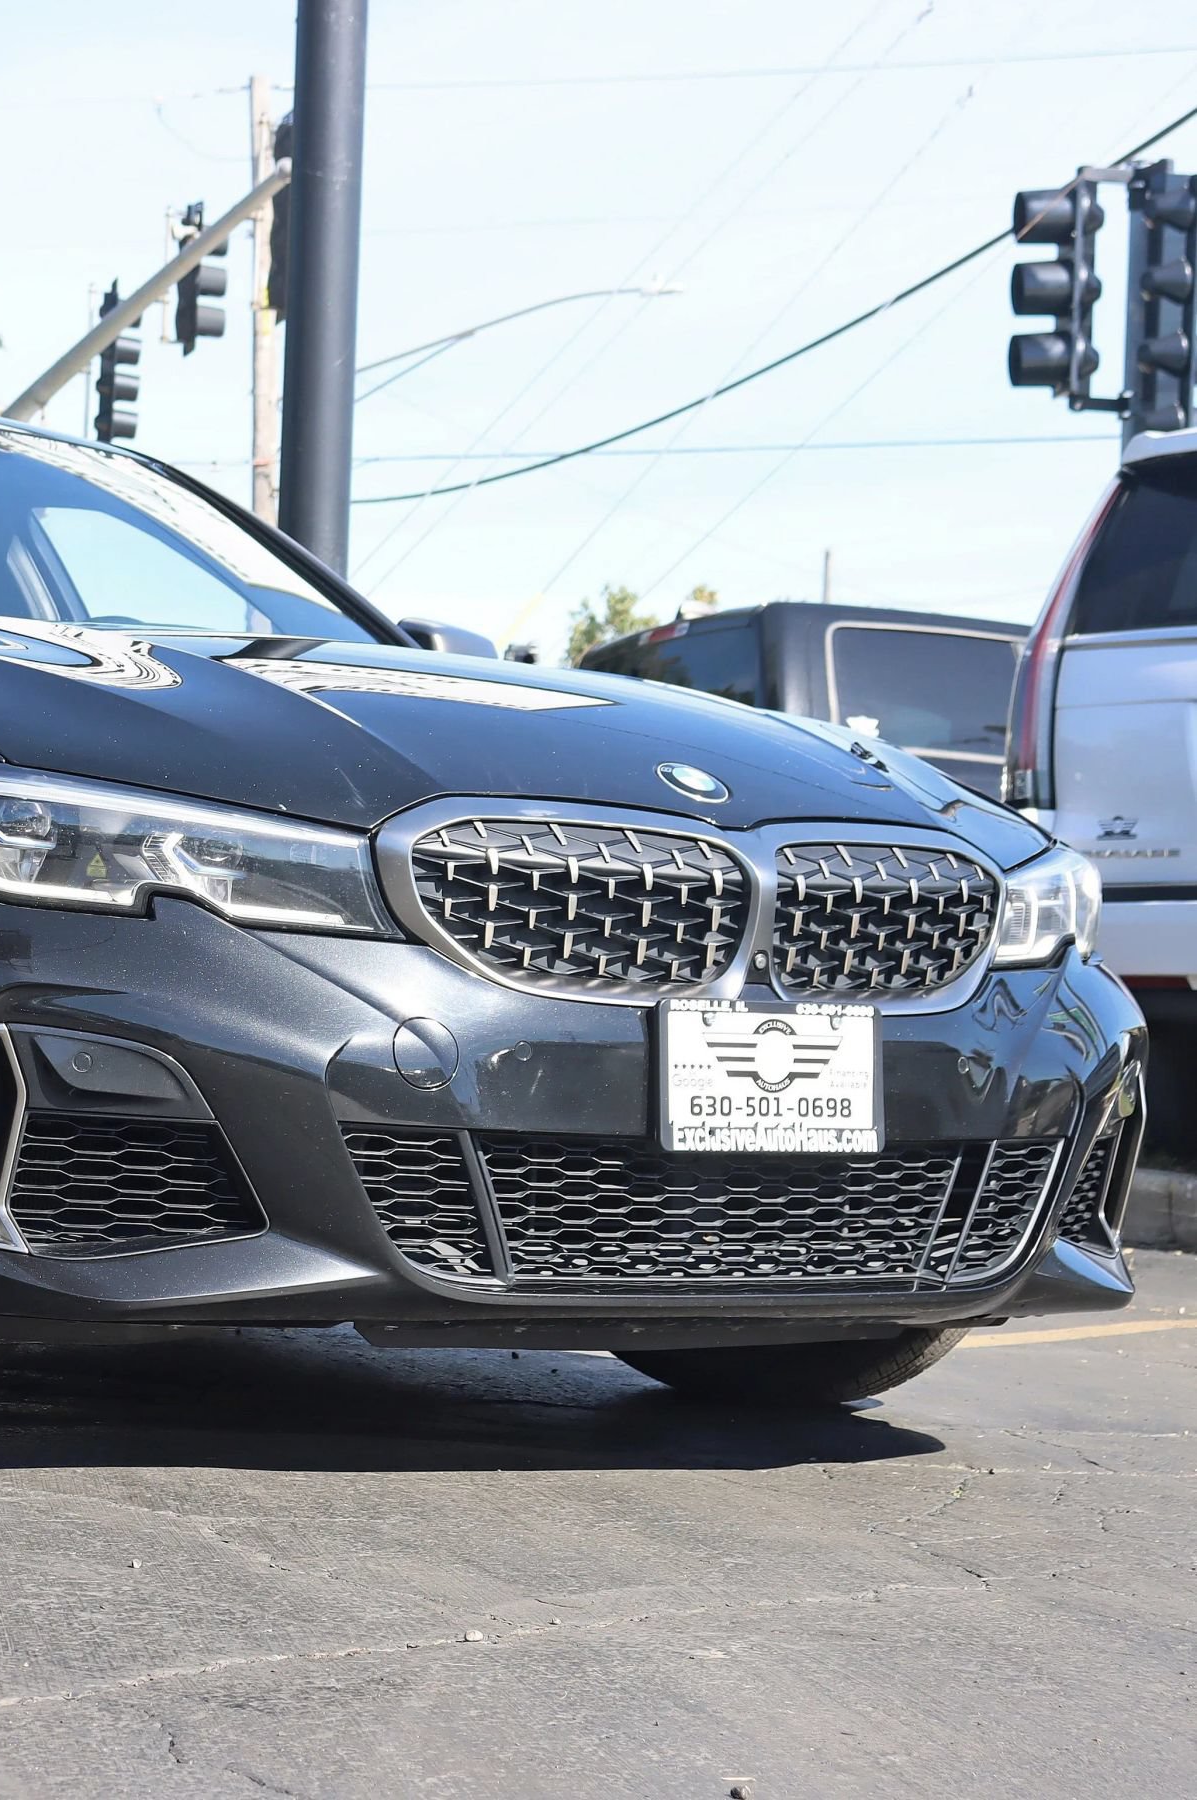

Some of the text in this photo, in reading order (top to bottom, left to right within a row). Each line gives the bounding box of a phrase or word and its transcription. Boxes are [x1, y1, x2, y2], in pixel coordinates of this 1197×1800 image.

[758, 1020, 792, 1036] EXCLUSIVE
[672, 1073, 714, 1091] Googe
[756, 1079, 791, 1092] AUTOHAUS
[690, 1096, 852, 1118] 630-501-0698
[673, 1122, 878, 1152] ExclusiveAutoHaus.com
